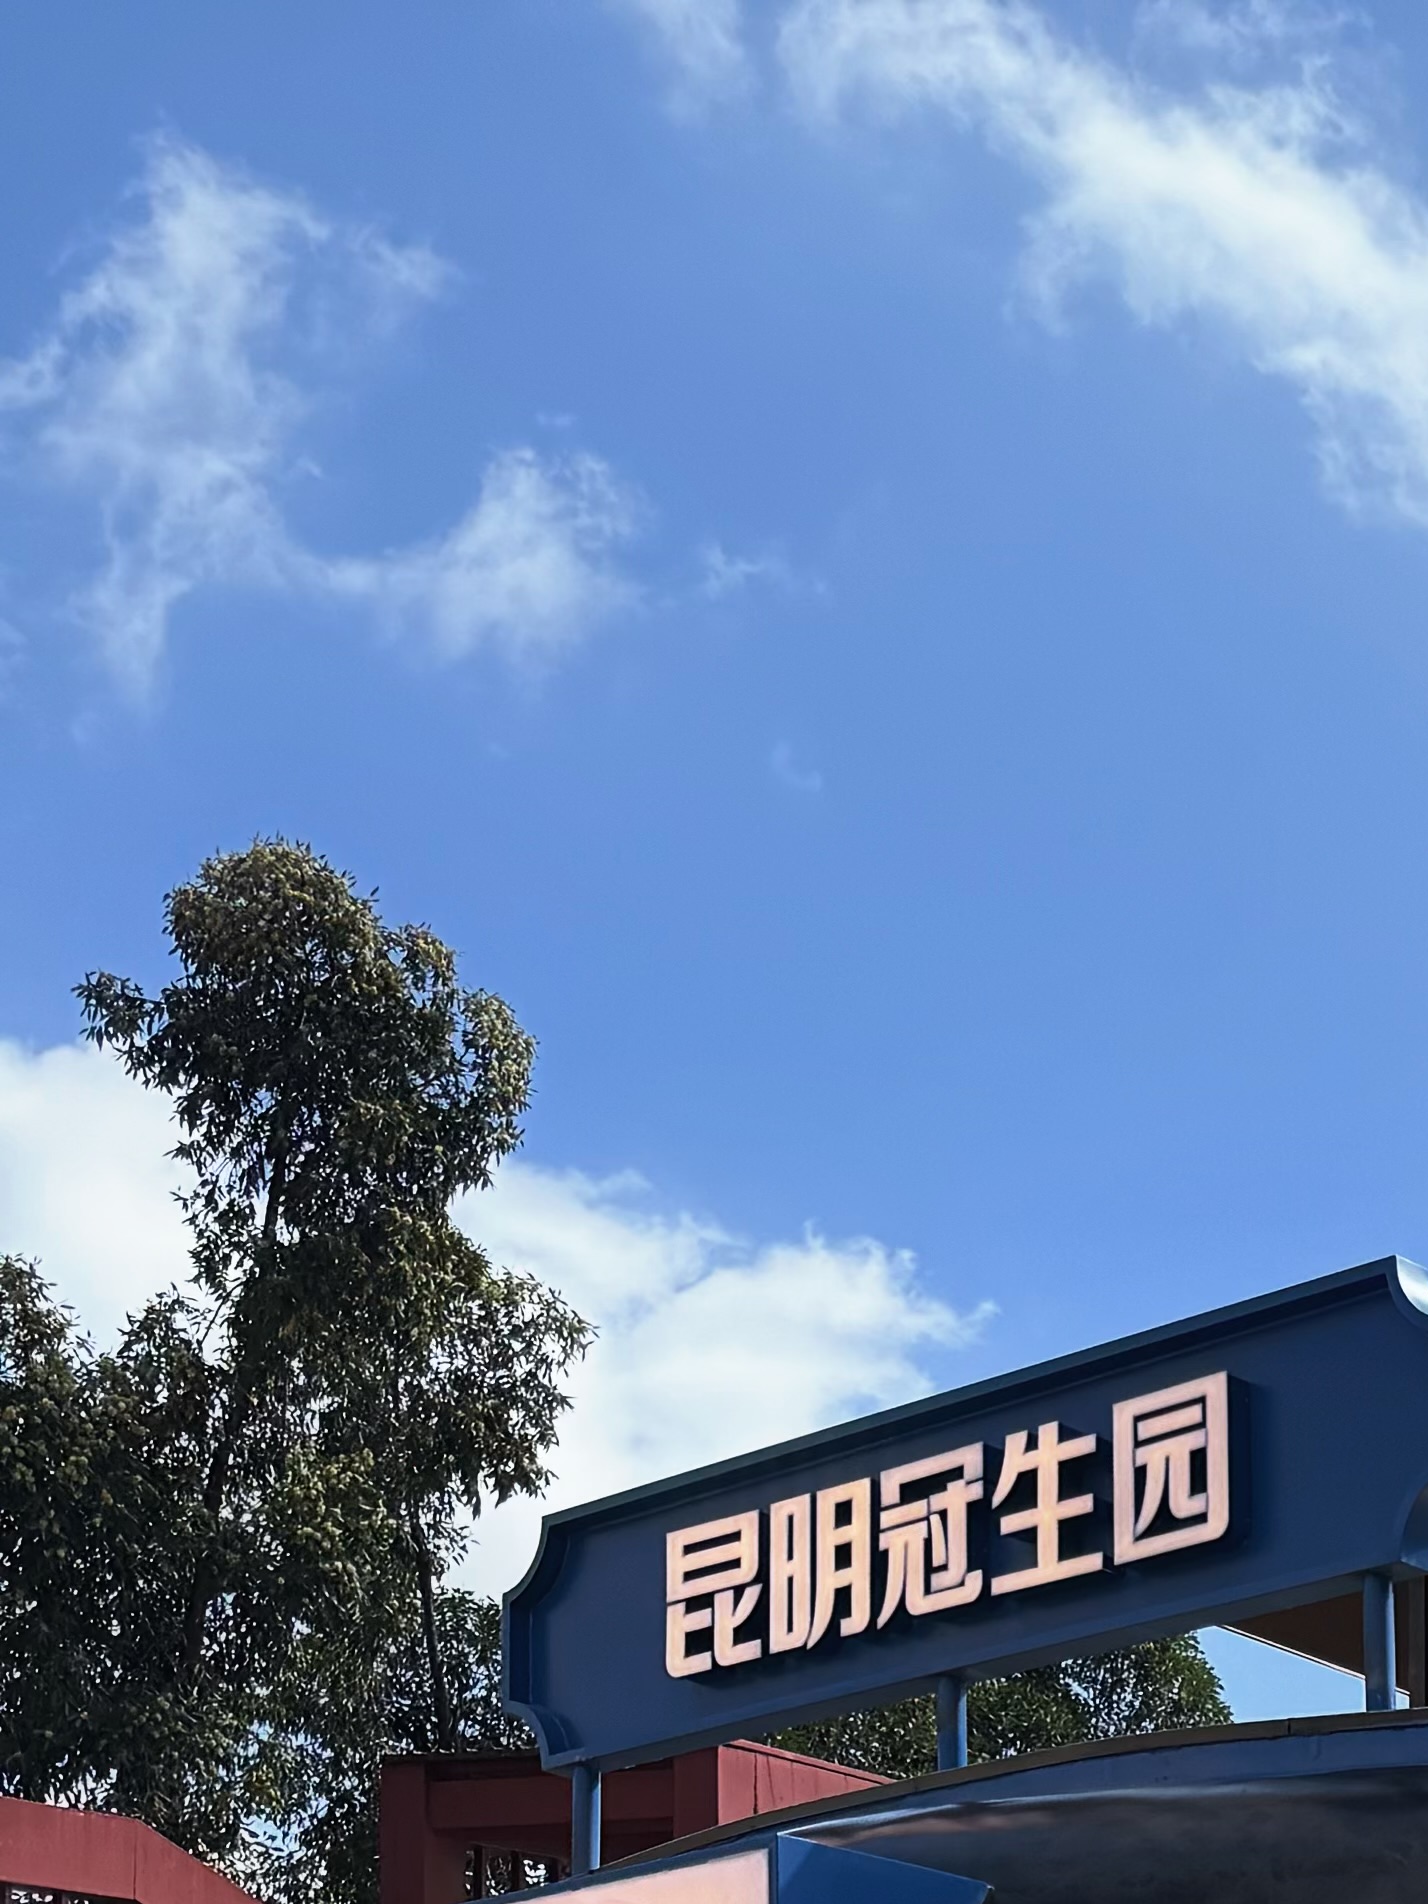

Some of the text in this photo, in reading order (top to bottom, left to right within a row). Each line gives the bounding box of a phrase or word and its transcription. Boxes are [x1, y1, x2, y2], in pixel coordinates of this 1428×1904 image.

[666, 1371, 1229, 1678] 昆明冠生园
